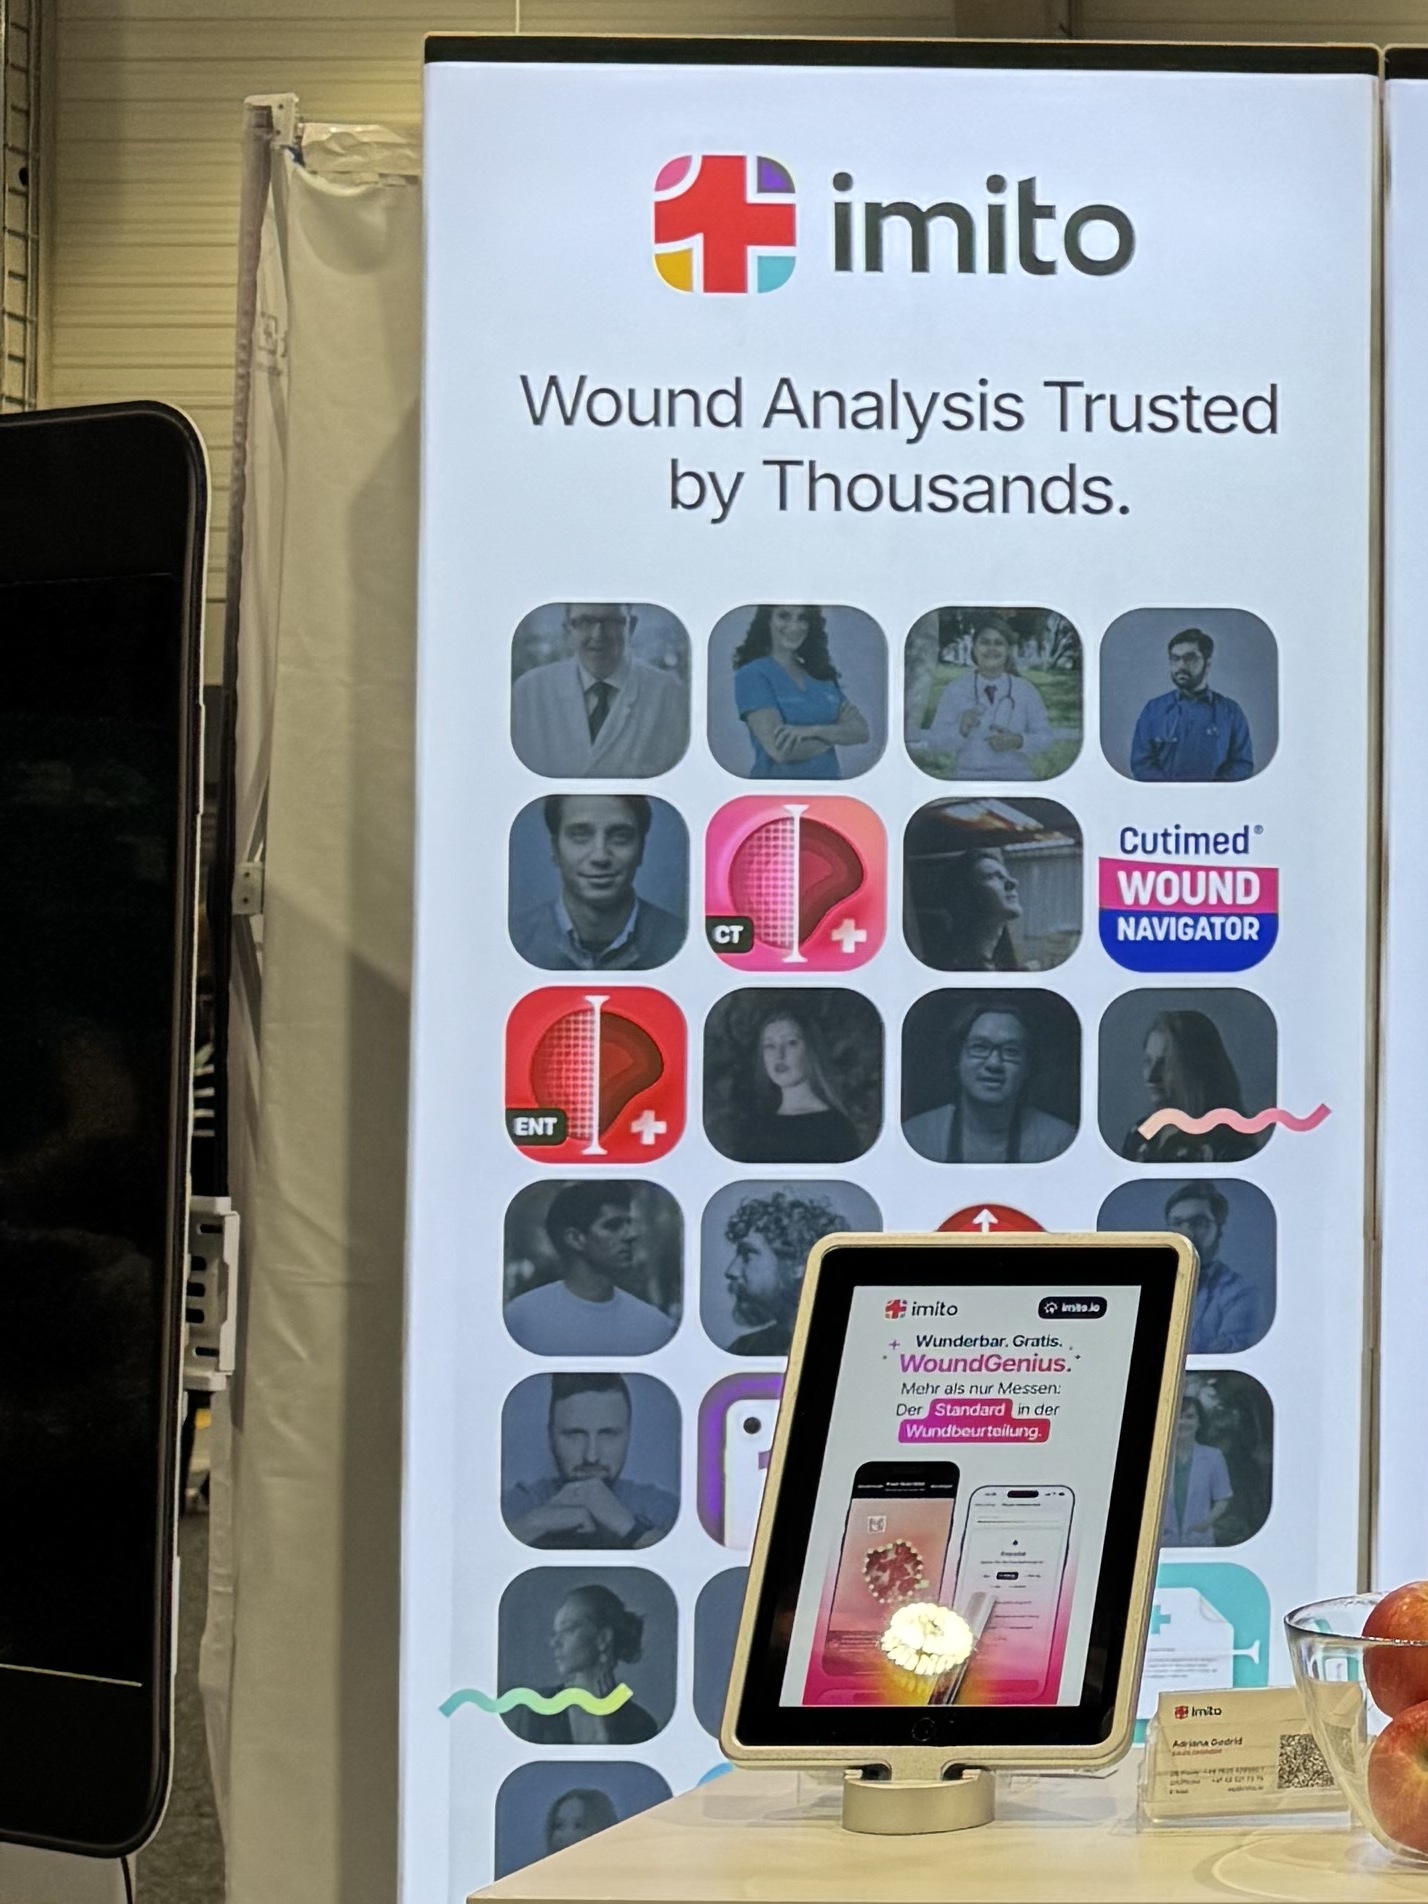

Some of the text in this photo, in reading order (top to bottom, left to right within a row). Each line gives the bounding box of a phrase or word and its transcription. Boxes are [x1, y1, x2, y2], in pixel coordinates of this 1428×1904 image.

[833, 172, 1135, 276] imito
[520, 375, 1277, 443] Wound Analysis Trusted
[671, 459, 1129, 524] by Thousands.
[1118, 871, 1259, 905] WOUND
[712, 924, 744, 944] CT
[1118, 916, 1259, 940] NAVIGATOR
[514, 1116, 558, 1137] ENT
[912, 1301, 958, 1316] imito
[1013, 1335, 1062, 1347] Gratis.
[901, 1353, 1071, 1372] WoundGenius.
[901, 1382, 1060, 1395] Mehr als nur Messen:
[896, 1403, 1060, 1416] Der Standard in der
[907, 1424, 1041, 1440] Wundbeurteilung.
